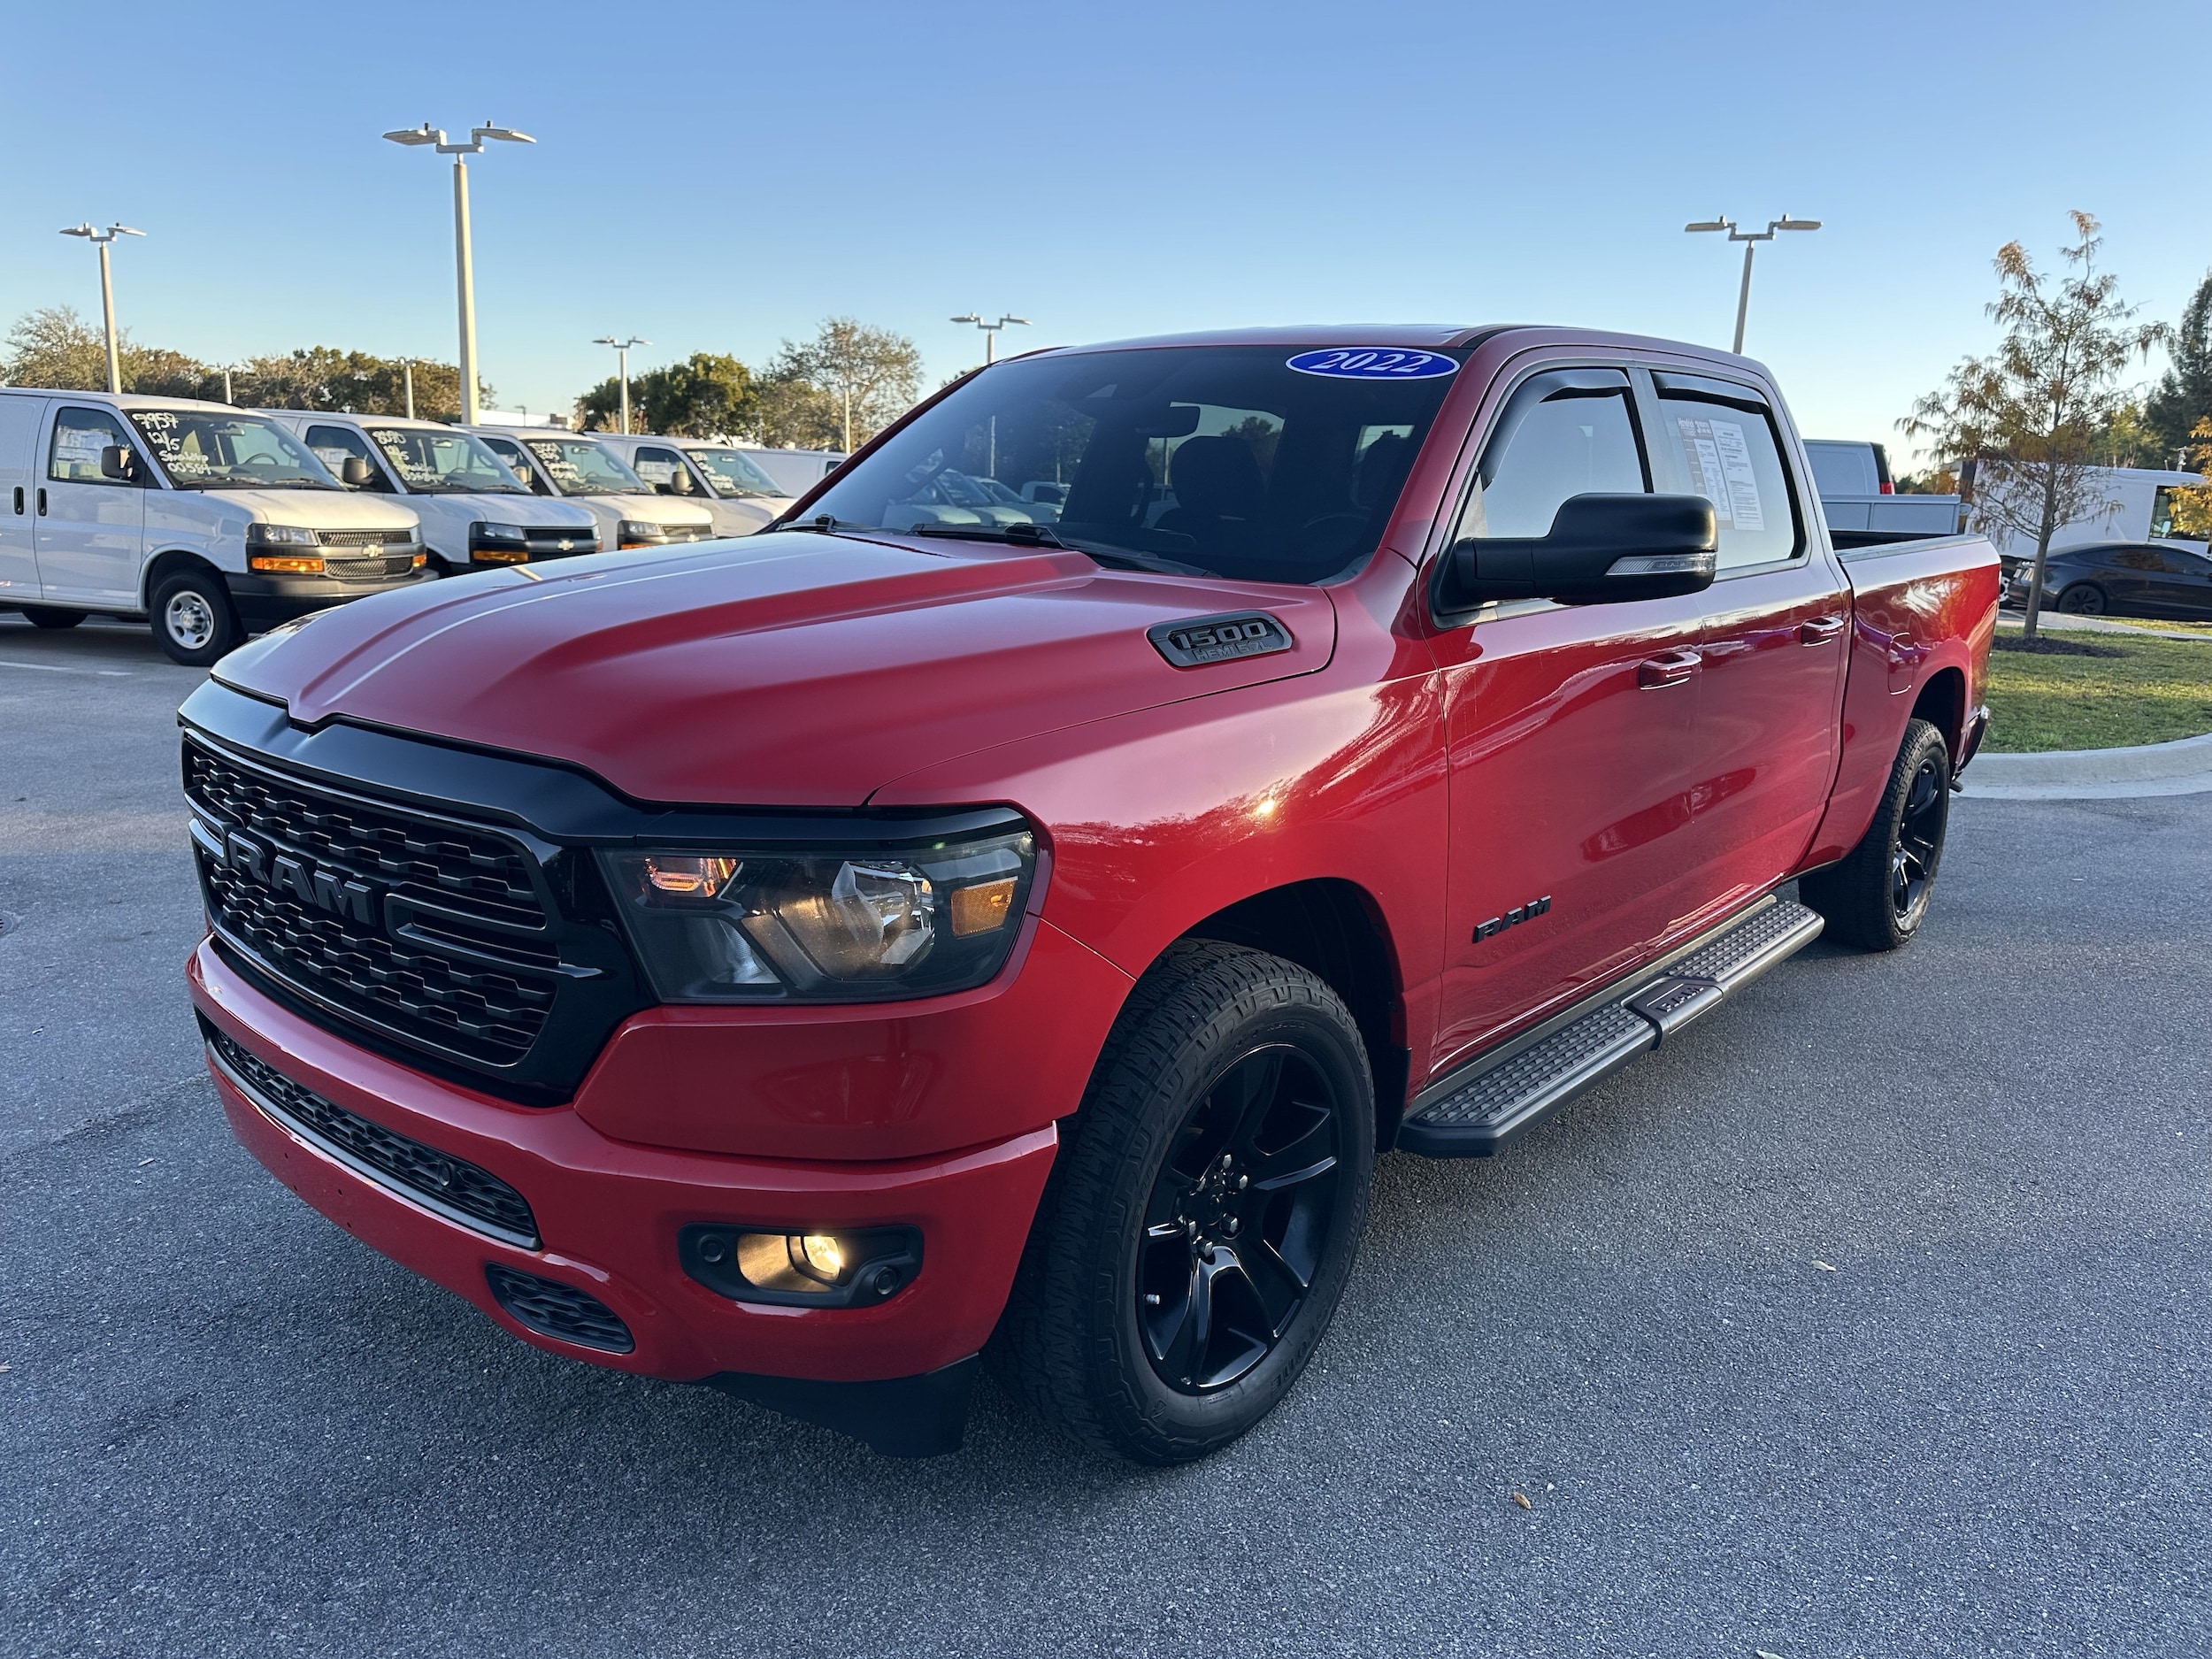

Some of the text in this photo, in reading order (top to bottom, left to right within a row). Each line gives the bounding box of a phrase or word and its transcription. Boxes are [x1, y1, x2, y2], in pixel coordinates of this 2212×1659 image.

[1308, 351, 1432, 373] 2022
[1175, 621, 1268, 649] 1500
[1192, 644, 1235, 661] HEMI
[227, 831, 377, 927] RAM
[1471, 895, 1552, 944] RAM
[1655, 987, 1705, 1013] RAM
[1270, 1173, 1367, 1395] BRIDGESTONE
